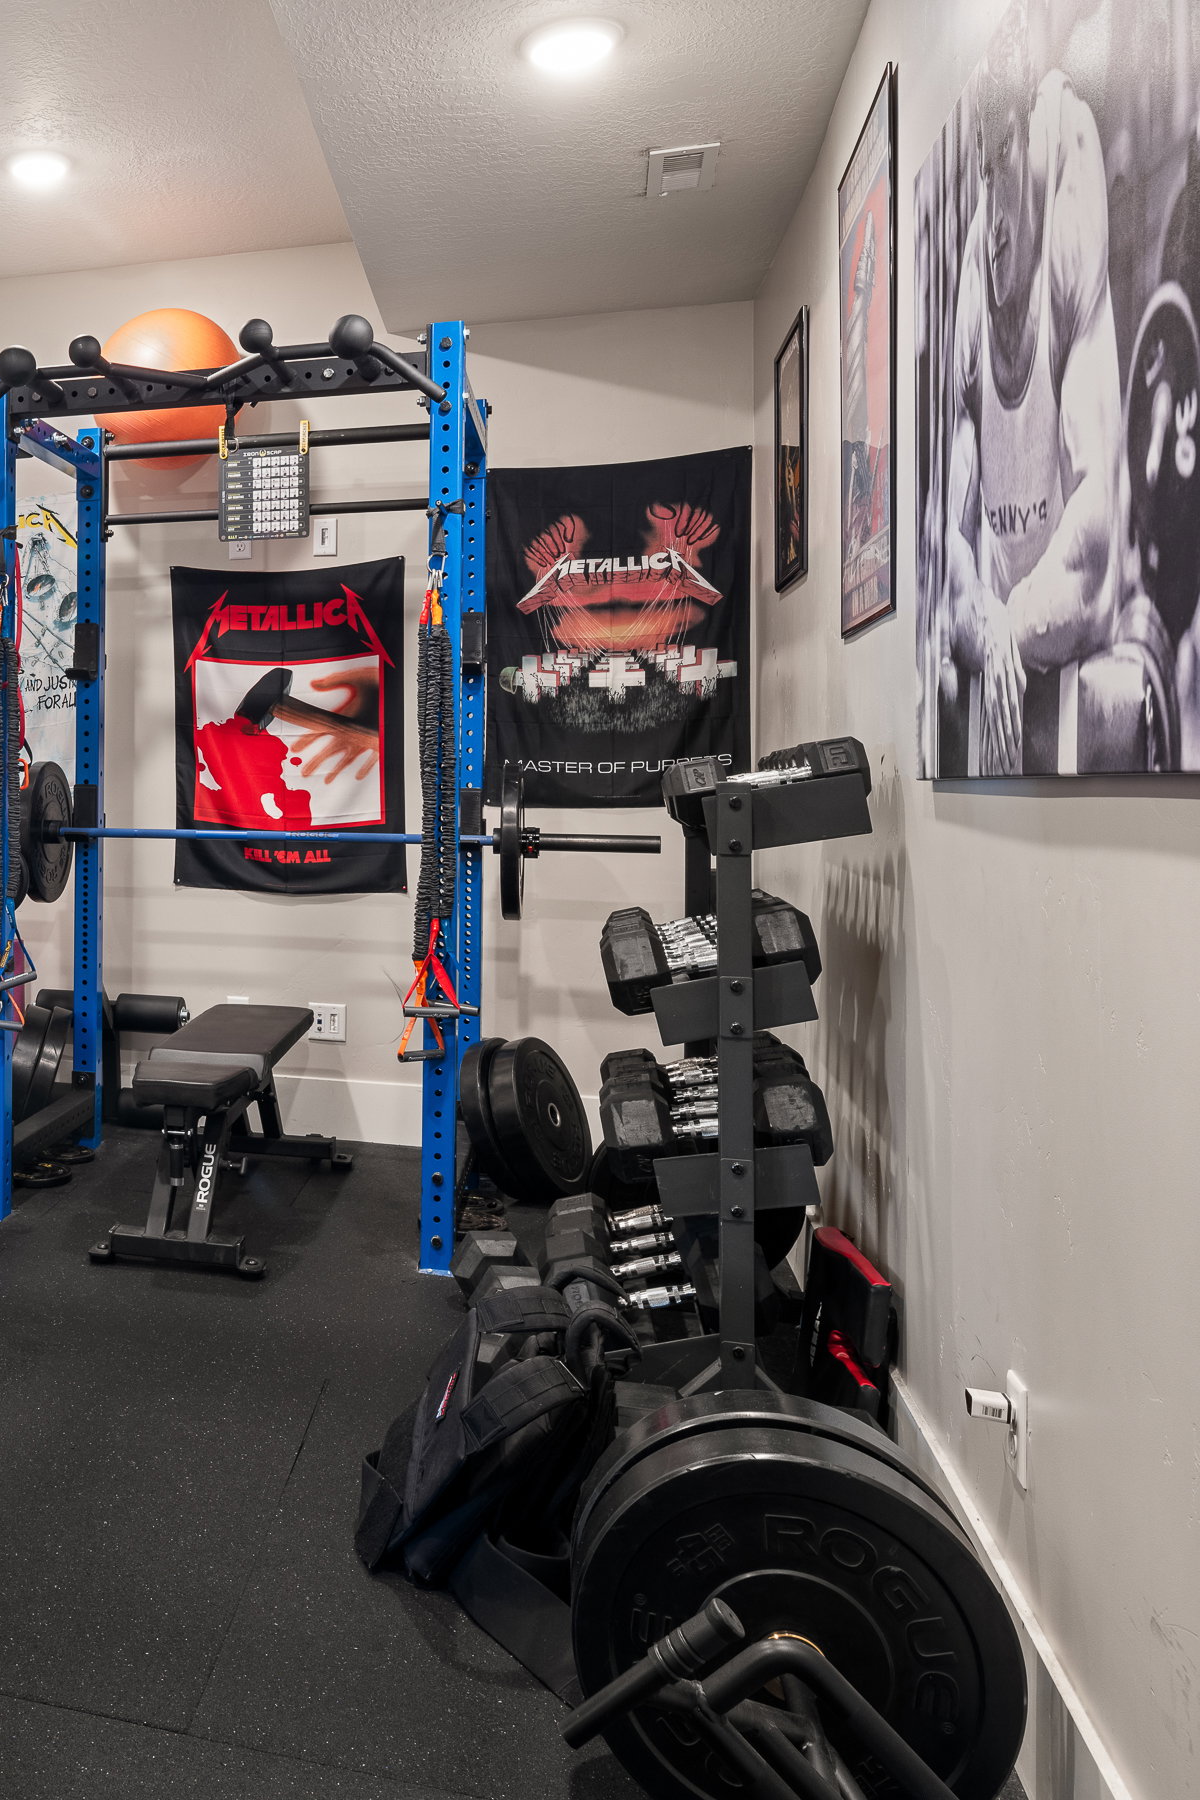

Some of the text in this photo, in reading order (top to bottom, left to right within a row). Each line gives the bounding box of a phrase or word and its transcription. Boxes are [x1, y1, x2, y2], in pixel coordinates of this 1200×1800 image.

[516, 546, 724, 613] METALLICA
[183, 583, 396, 673] METALLICA
[25, 678, 43, 692] AND
[38, 694, 61, 711] FOR
[504, 759, 593, 774] ASTER
[597, 761, 625, 774] OF
[244, 847, 332, 864] KILL 'EM ALL
[196, 1143, 217, 1203] ROGUE
[764, 1513, 961, 1720] ROGUE
